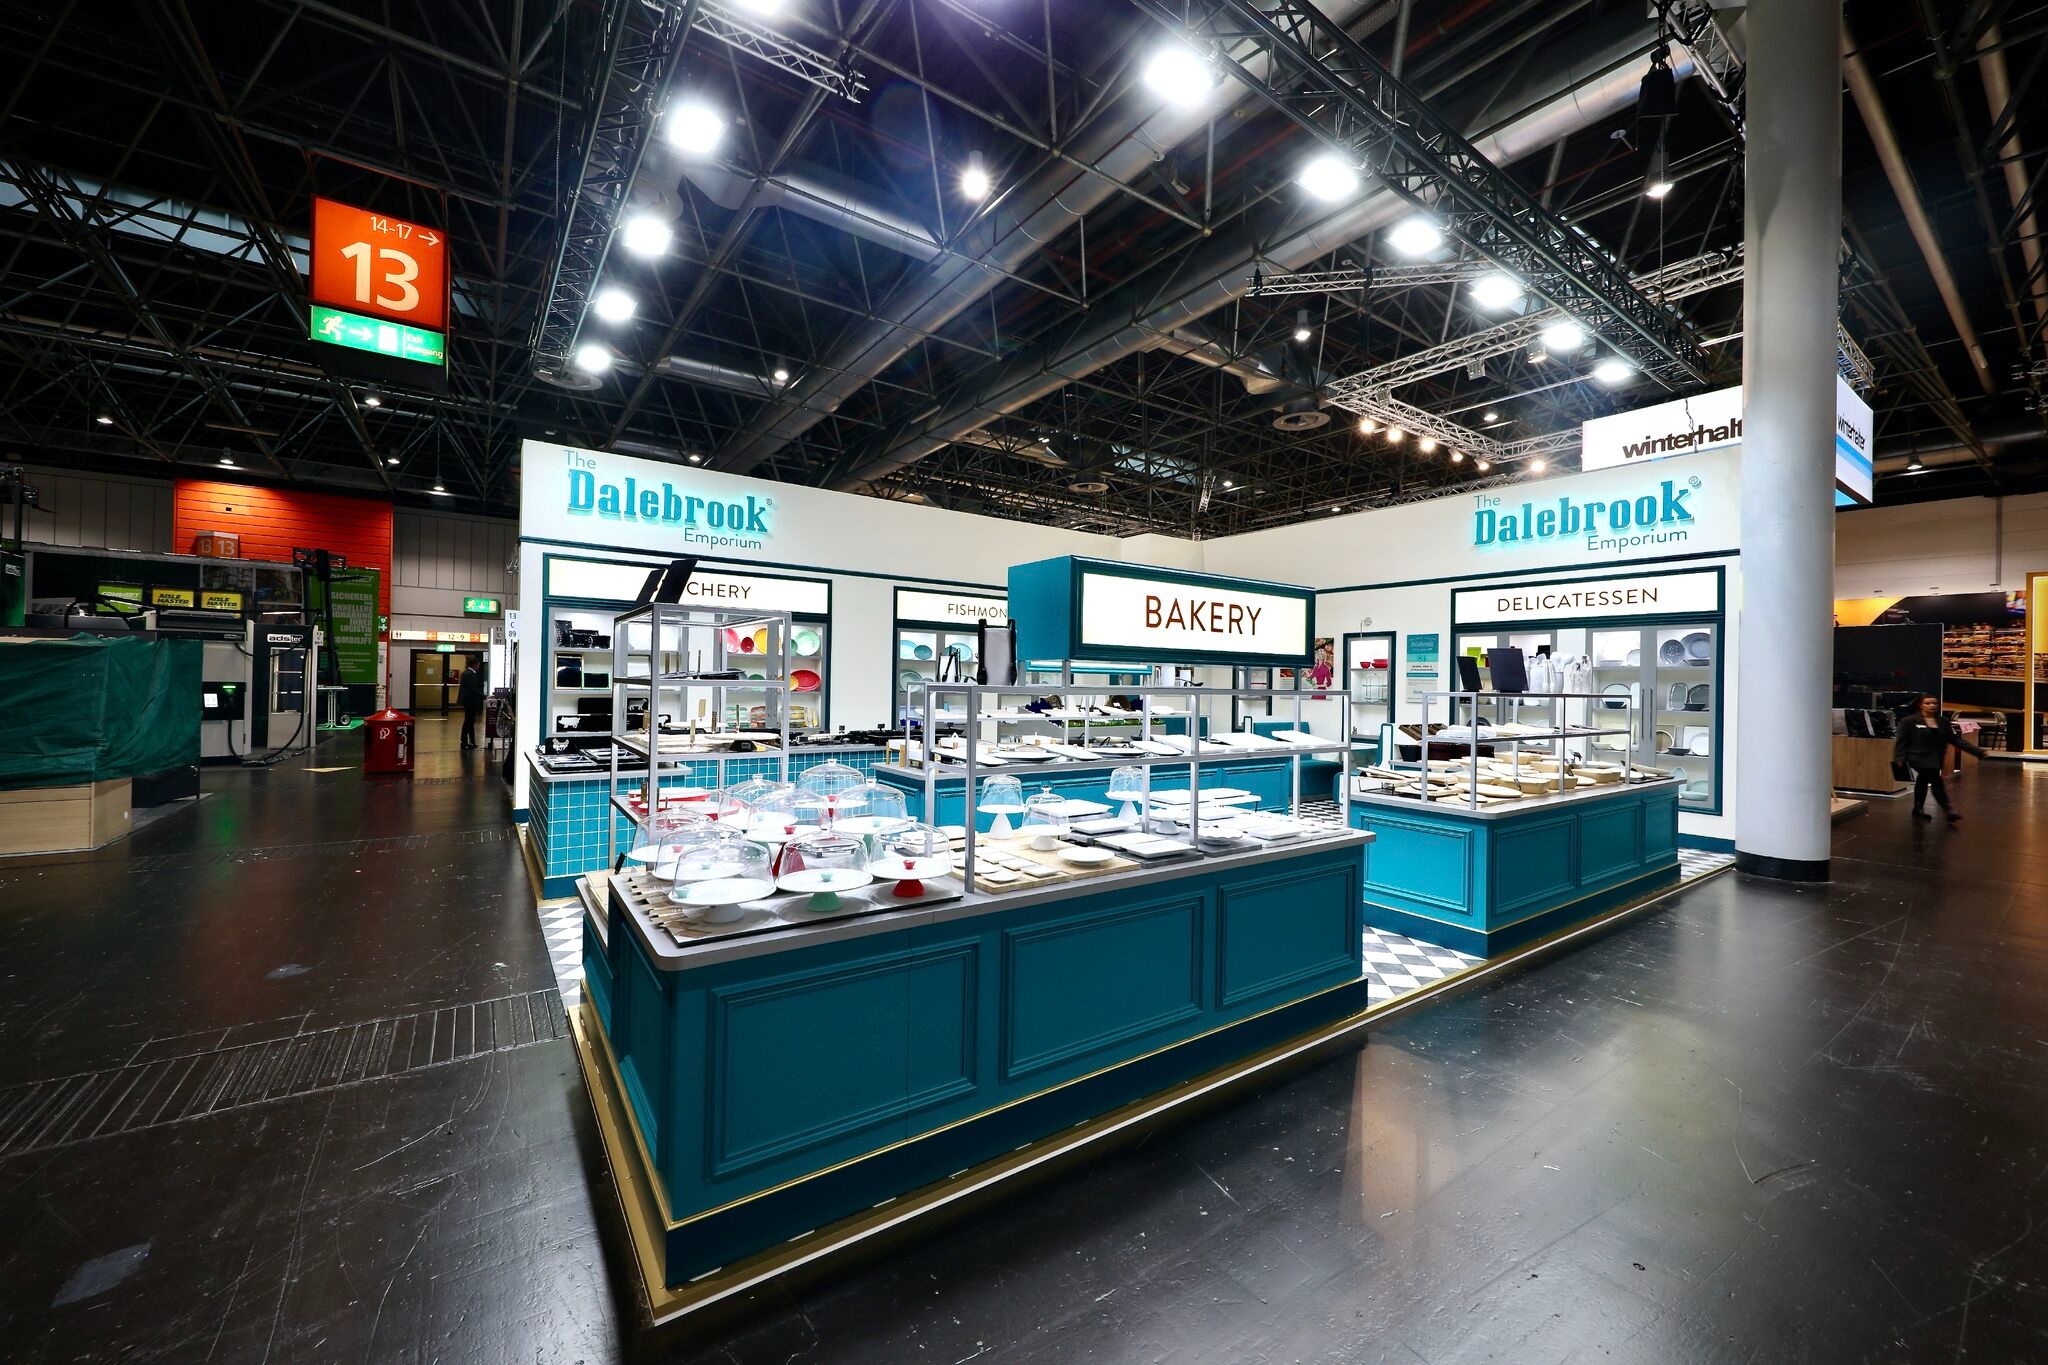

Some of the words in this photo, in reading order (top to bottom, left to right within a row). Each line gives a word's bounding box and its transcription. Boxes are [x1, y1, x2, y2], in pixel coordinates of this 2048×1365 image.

[370, 216, 412, 240] 14-17
[341, 241, 420, 312] 13
[564, 450, 597, 469] The
[1473, 494, 1500, 508] The
[218, 540, 235, 556] 13
[684, 527, 762, 549] Emporium
[1587, 528, 1688, 553] Emporium
[686, 581, 752, 599] CHERY
[1498, 587, 1658, 611] DELICATESSEN
[509, 612, 517, 620] 13
[948, 603, 1007, 618] FISHMON
[1145, 594, 1262, 635] BAKERY
